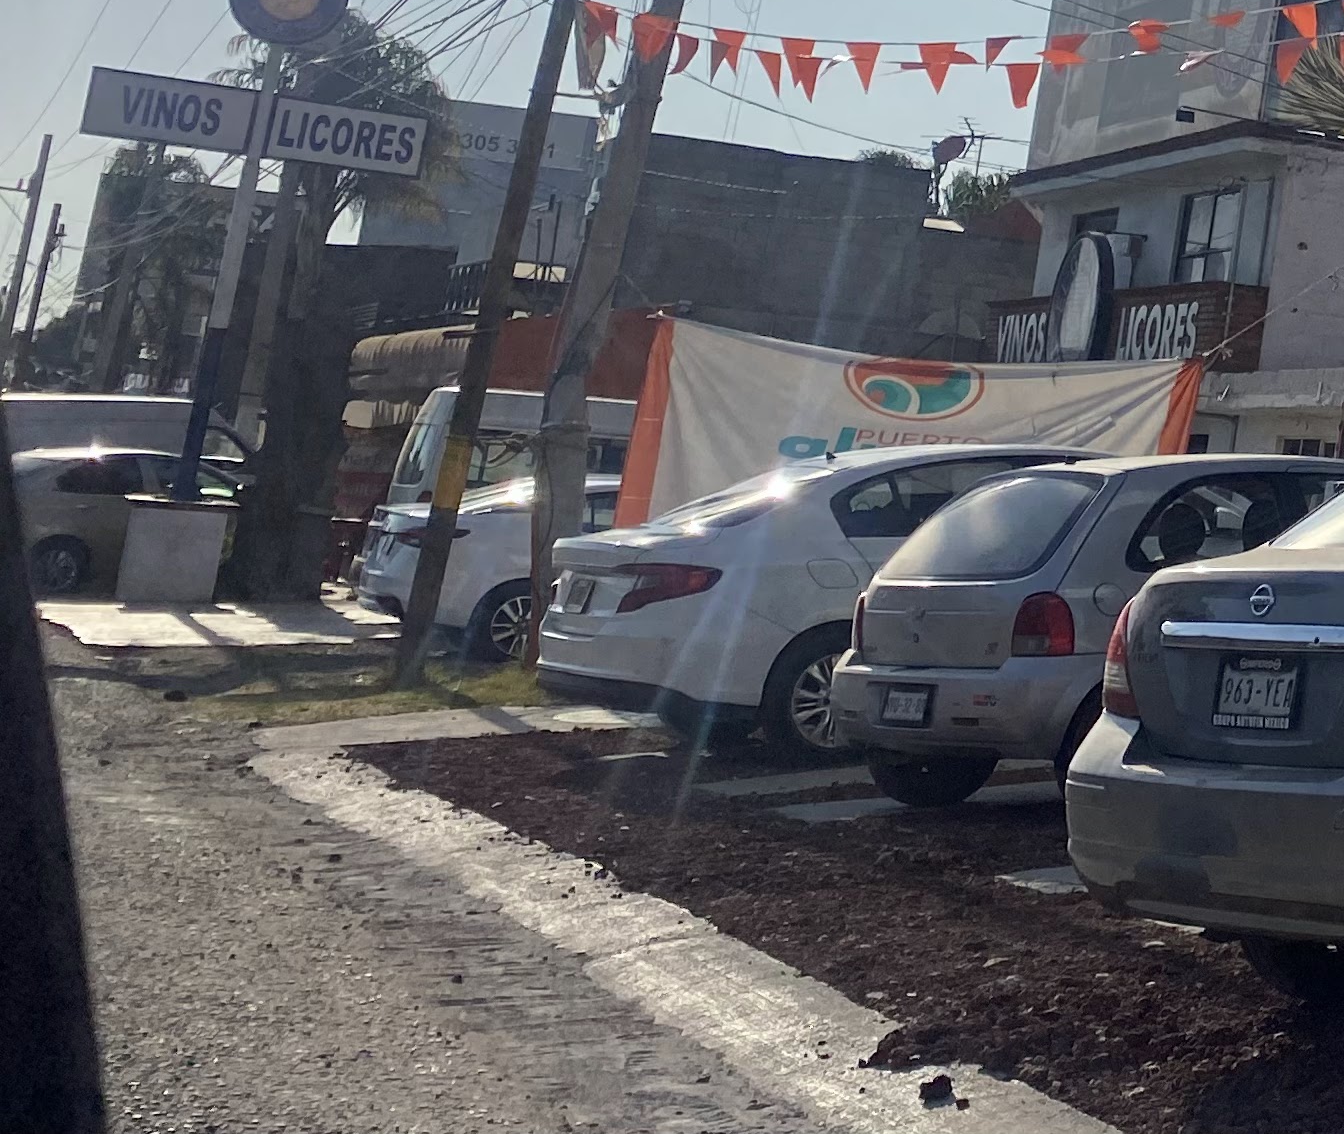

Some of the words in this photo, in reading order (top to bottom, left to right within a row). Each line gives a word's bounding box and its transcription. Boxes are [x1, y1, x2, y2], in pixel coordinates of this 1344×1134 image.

[122, 84, 223, 137] VINOS
[276, 109, 416, 165] LICORES
[996, 312, 1049, 363] VINOS
[1115, 301, 1200, 362] LICORES
[1223, 677, 1295, 708] 963-YEA
